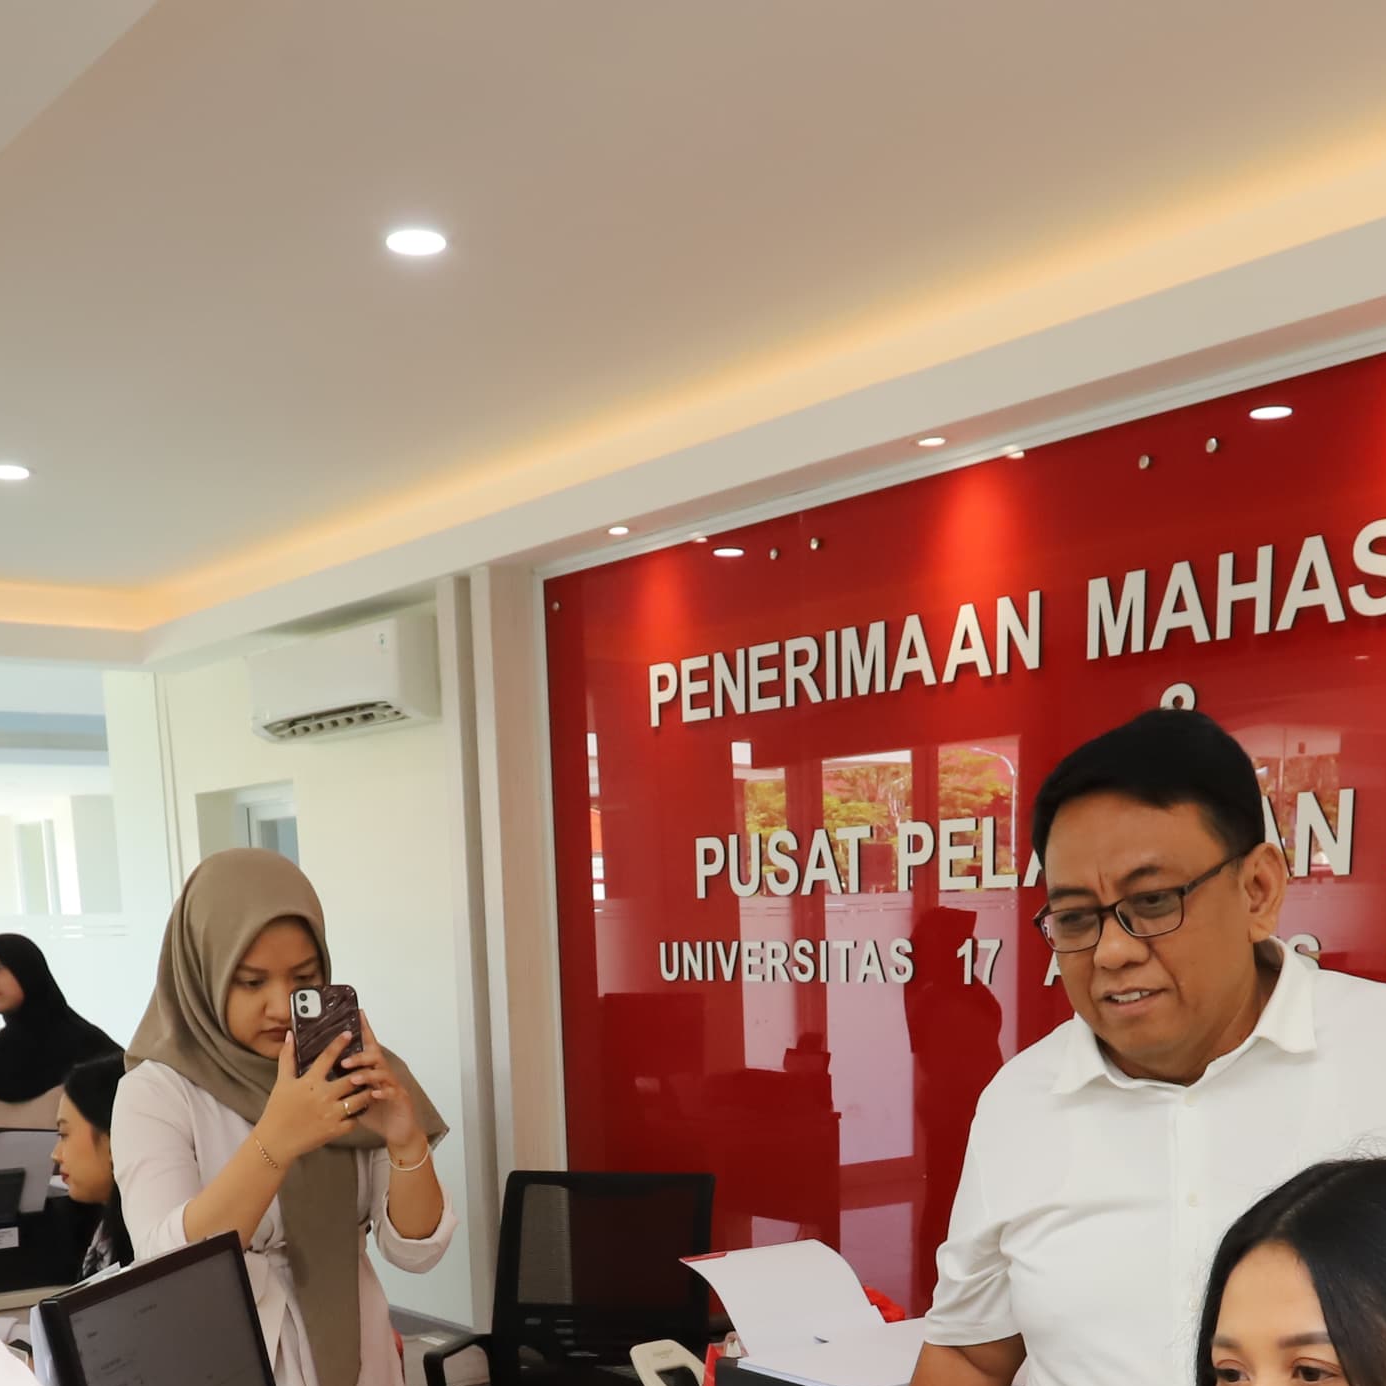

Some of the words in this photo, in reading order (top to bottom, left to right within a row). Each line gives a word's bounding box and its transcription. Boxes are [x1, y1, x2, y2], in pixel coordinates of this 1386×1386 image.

[649, 590, 1041, 727] PENERIMAAN
[695, 826, 872, 899] PUSAT
[659, 936, 914, 983] UNIVERSITAS
[956, 938, 1003, 985] 17
